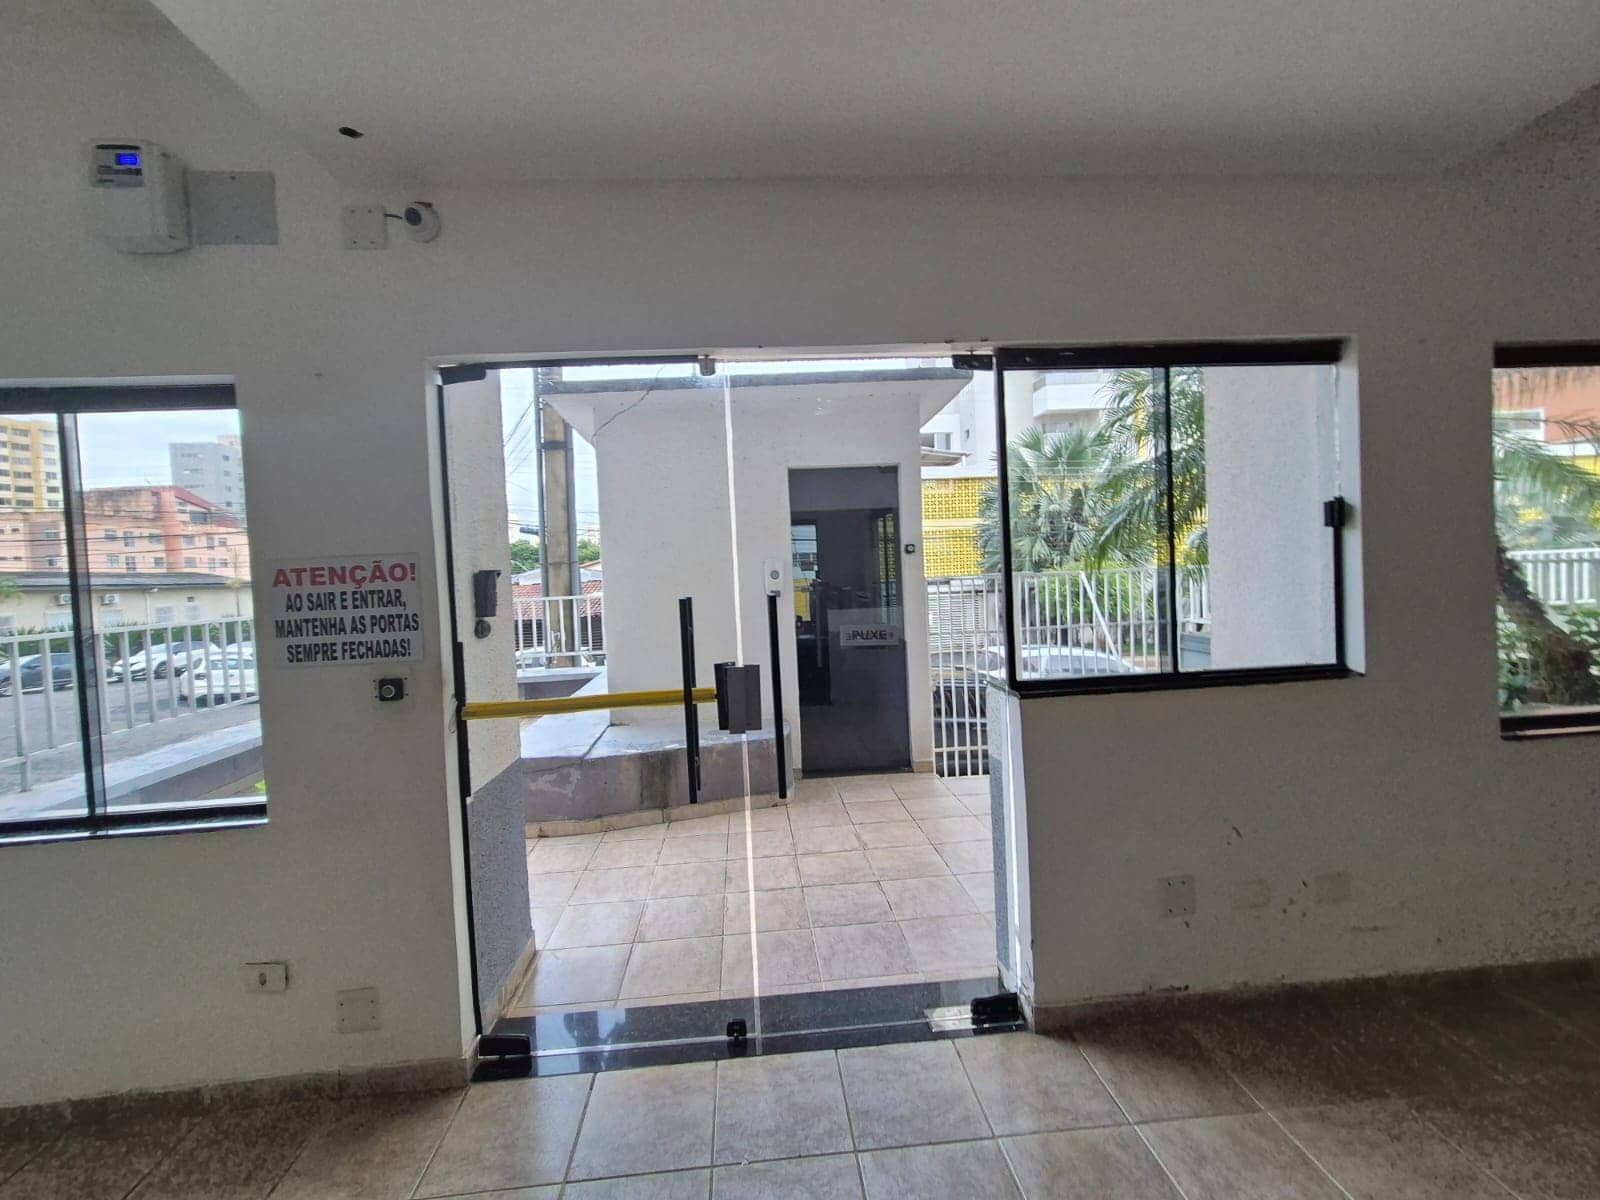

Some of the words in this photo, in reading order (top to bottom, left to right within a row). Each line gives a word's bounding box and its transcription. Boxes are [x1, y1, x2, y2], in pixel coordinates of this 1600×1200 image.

[273, 560, 416, 589] ATENÇÃO!
[285, 593, 303, 612] AO
[306, 591, 337, 611] SAIR
[340, 591, 348, 610] E
[352, 588, 407, 610] ENTRAR,
[275, 617, 347, 638] MANTENHA
[350, 615, 367, 634] AS
[370, 613, 420, 633] PORTAS
[287, 642, 338, 663] SEMPRE
[341, 638, 411, 660] FECHADAS!
